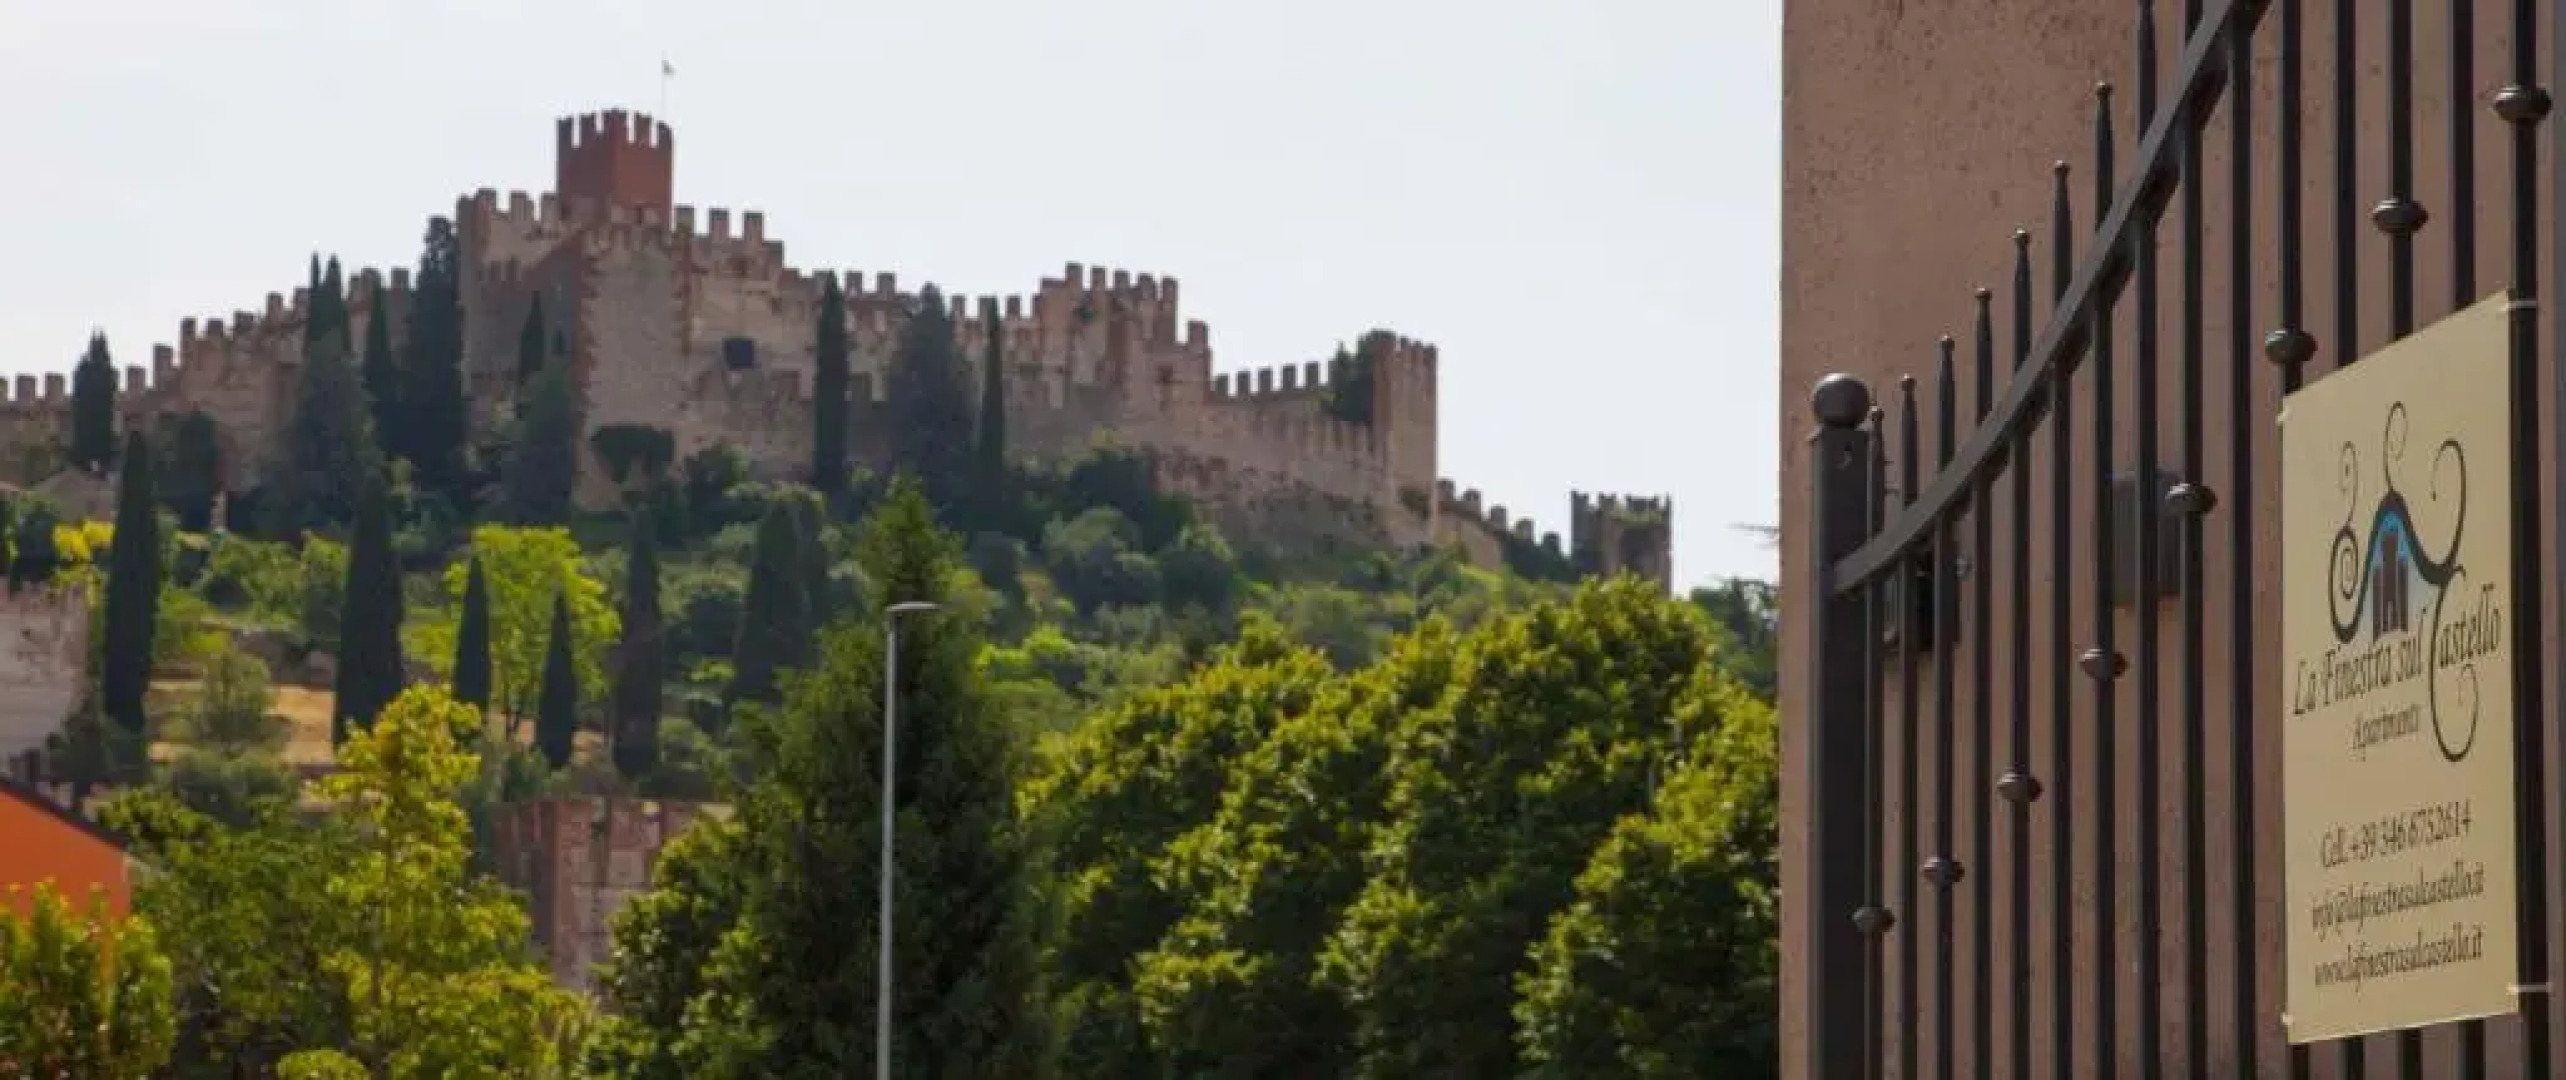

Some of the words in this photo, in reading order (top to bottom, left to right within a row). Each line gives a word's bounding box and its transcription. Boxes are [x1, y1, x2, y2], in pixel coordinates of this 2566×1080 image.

[2294, 658, 2316, 715] La
[2323, 641, 2392, 706] Finestra
[2397, 607, 2427, 682] sul
[2352, 821, 2376, 862] +39
[2380, 814, 2405, 857] 346
